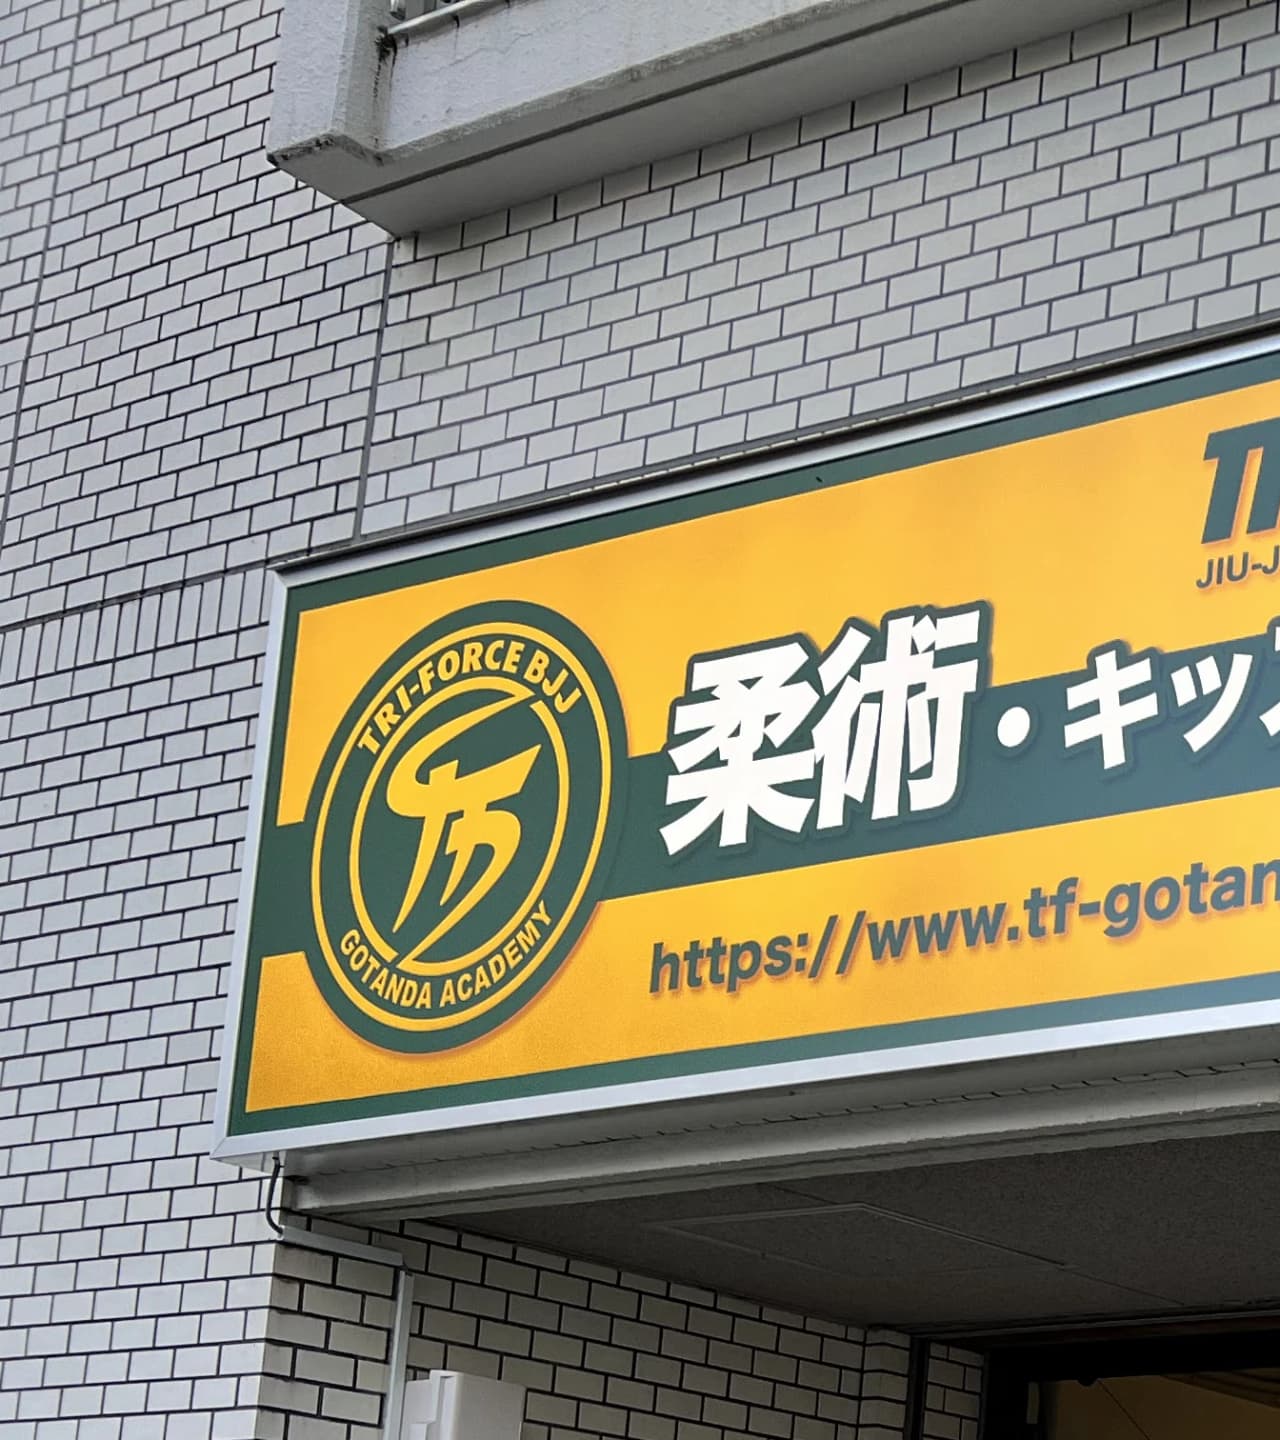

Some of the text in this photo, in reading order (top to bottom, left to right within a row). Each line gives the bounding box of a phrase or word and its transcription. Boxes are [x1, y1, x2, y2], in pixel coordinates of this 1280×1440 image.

[357, 639, 583, 756] TRI-FORCE BJJ
[340, 900, 554, 1010] GOTANDA ACADEMY
